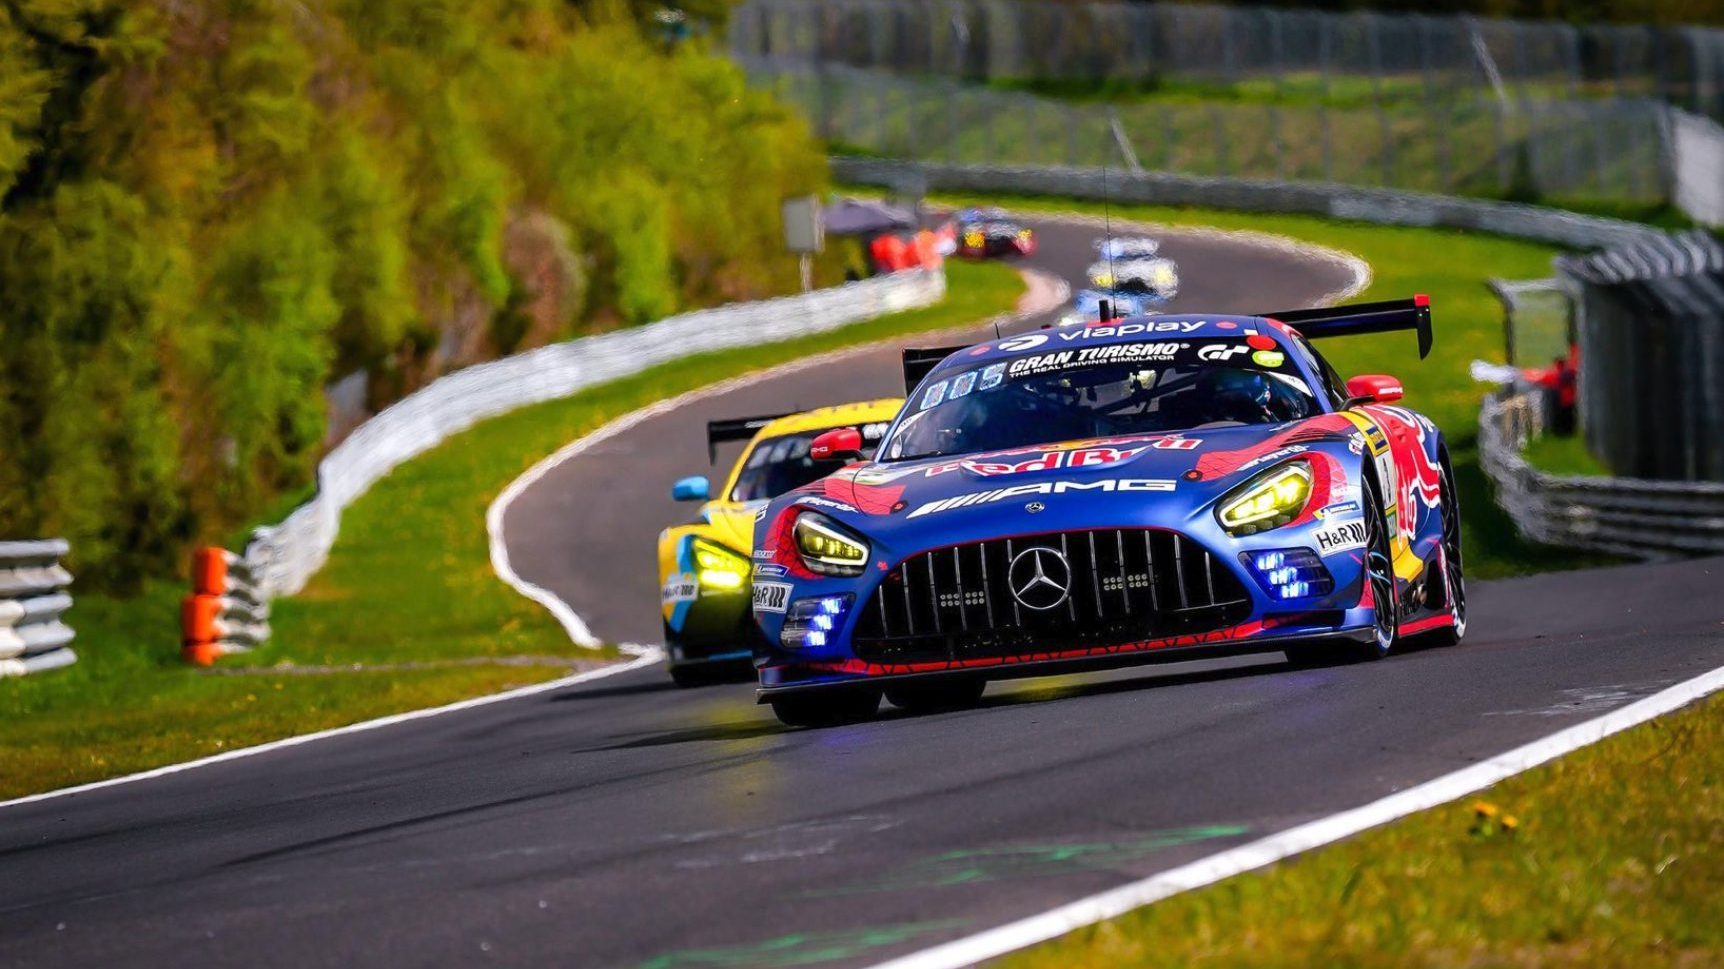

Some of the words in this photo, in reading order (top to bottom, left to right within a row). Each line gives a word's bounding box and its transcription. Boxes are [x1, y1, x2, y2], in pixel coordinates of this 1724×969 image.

[1058, 320, 1206, 341] viaplay
[1009, 349, 1075, 374] GRAN
[1009, 368, 1031, 378] THE
[1033, 363, 1061, 374] REAL
[1062, 358, 1107, 369] DRIVING
[1109, 354, 1175, 364] SIMULATOR
[1316, 527, 1352, 549] H&R
